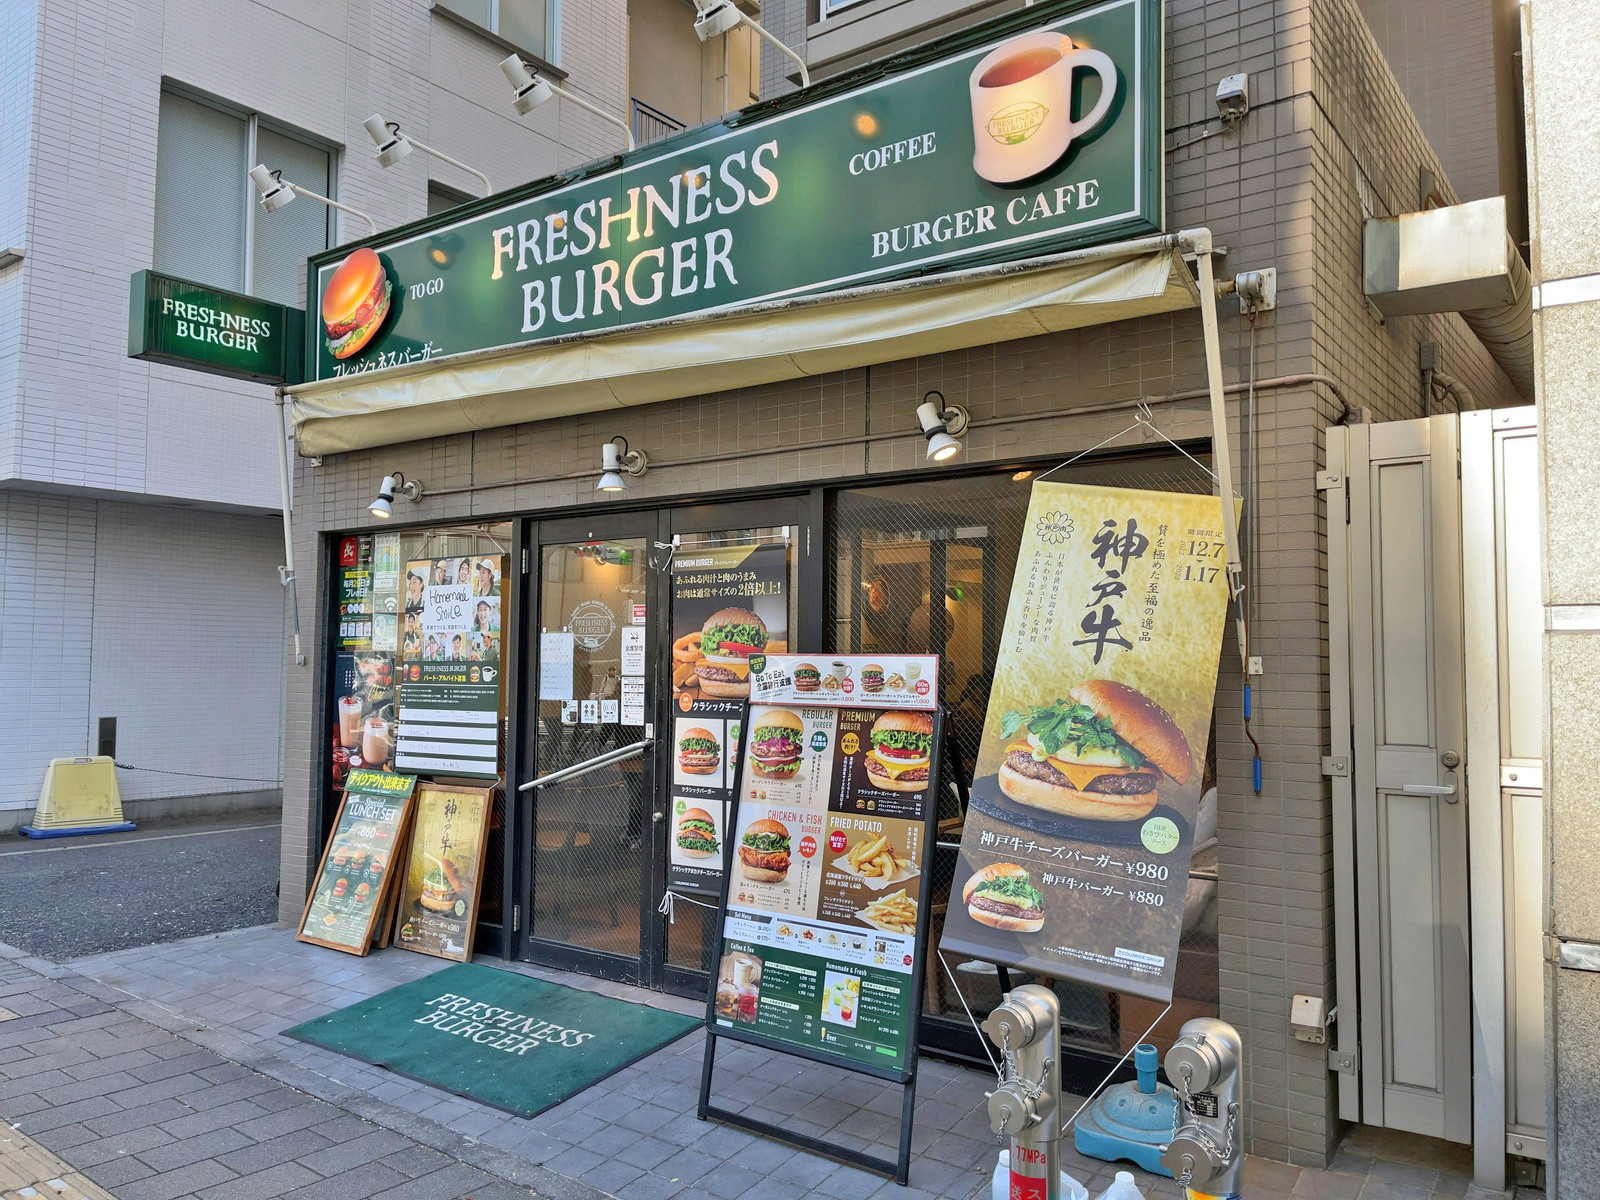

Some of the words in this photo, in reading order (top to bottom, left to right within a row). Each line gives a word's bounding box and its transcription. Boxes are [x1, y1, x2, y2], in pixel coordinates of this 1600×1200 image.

[993, 108, 1039, 128] FRESHNESS
[996, 118, 1036, 134] BURGER
[849, 132, 936, 176] COFFEE
[492, 140, 778, 280] FRESHNESS
[872, 204, 996, 258] BURGER
[1006, 178, 1100, 225] CAFE
[521, 228, 738, 333] BURGER
[162, 297, 270, 338] FRESHNESS
[176, 320, 258, 353] BURGER
[1188, 528, 1222, 538] 期間限定
[1188, 540, 1226, 558] 12.7
[675, 559, 695, 568] PREMIUM
[696, 558, 714, 567] BURGER
[676, 572, 757, 585] あふれる肉汁と肉のうまみ
[1138, 524, 1168, 642] 贅を極めた至福の逸品
[1184, 565, 1220, 584] 1.17
[1042, 552, 1066, 642] 日本が世界に誇る神戸牛
[1072, 518, 1150, 665] 神戸牛
[765, 672, 772, 681] To
[773, 669, 785, 679] Eat
[802, 710, 833, 720] REGULAR
[841, 711, 876, 722] PREMIUM
[812, 721, 833, 729] BURGER
[349, 772, 412, 791] テイクアウト出来ます
[681, 786, 715, 795] クラシックバーガー
[857, 789, 900, 797] クラシックチーズバーガー
[349, 804, 379, 818] LUNCH
[380, 808, 397, 821] SET
[767, 810, 796, 822] CHICKEN
[798, 814, 804, 823] &
[806, 815, 822, 825] FISH
[801, 826, 821, 834] BURGER
[830, 817, 851, 830] FRIED
[854, 820, 882, 832] POTATO
[979, 830, 1124, 868] 神戸牛チーズバーガー
[1125, 860, 1169, 881] ¥980
[1042, 872, 1124, 897] 神戸牛バーガー
[1128, 890, 1164, 907] ¥880
[731, 943, 743, 951] Coffee
[826, 962, 849, 972] Homemade
[854, 968, 867, 976] Fresh
[424, 993, 597, 1048] FRESHNESS
[414, 1008, 540, 1055] BURGER
